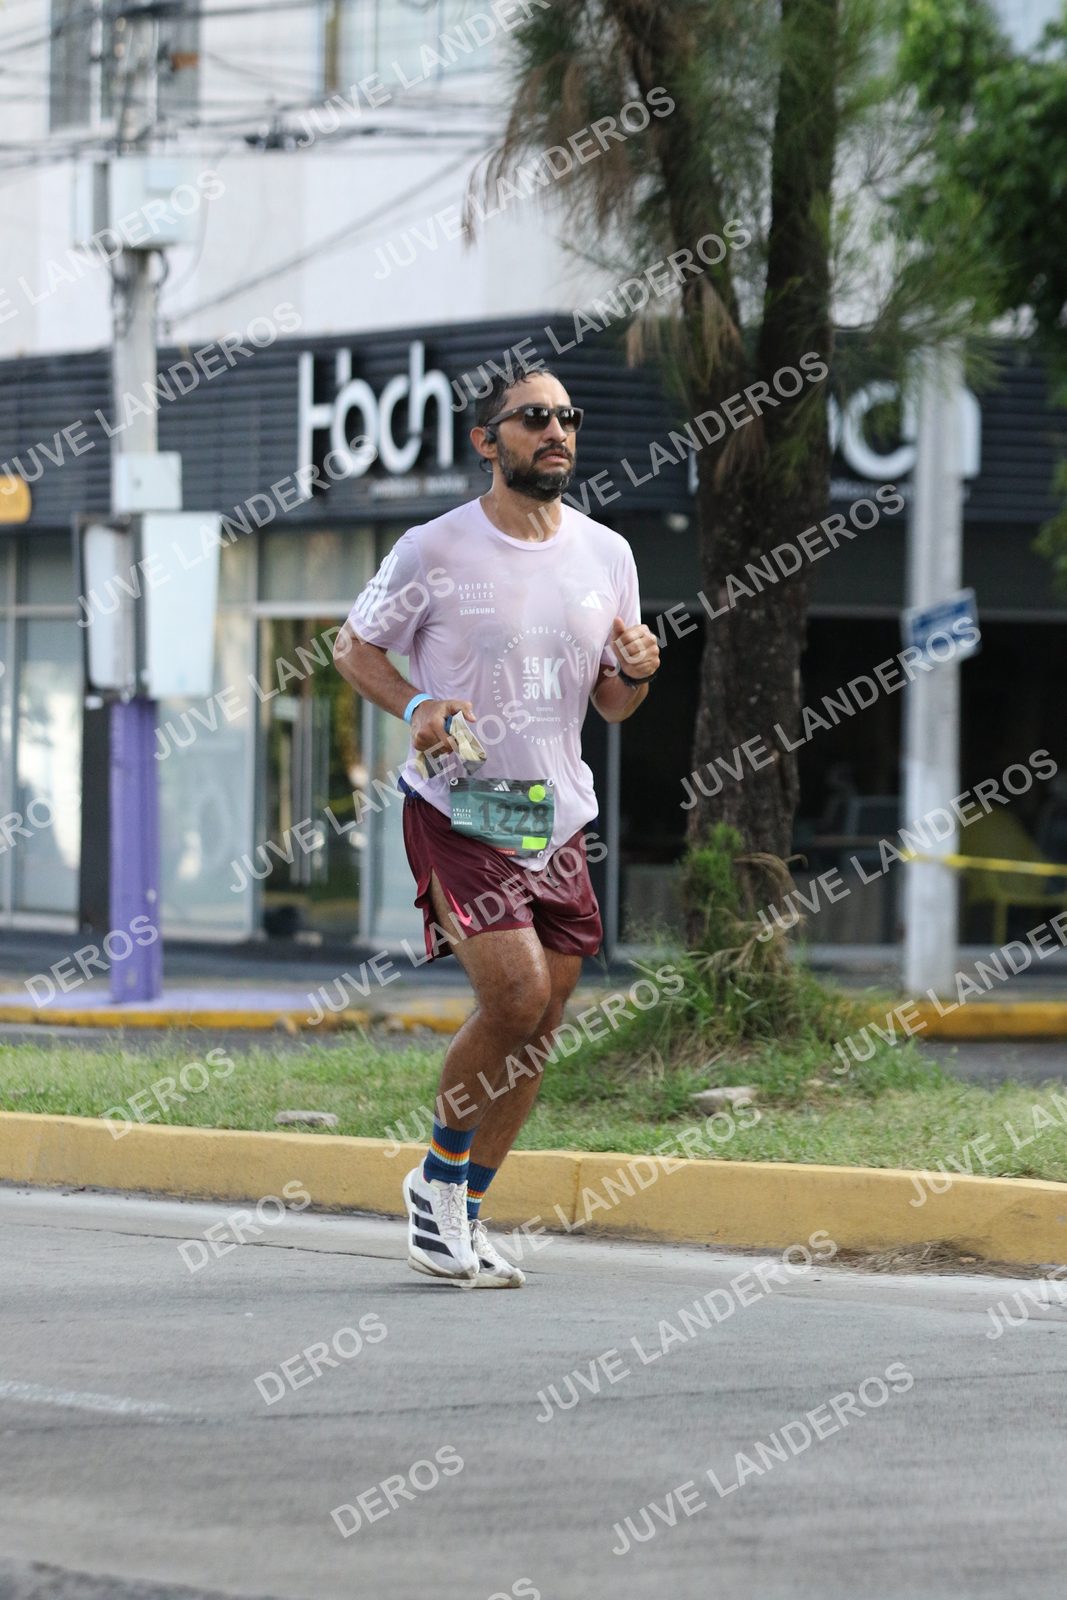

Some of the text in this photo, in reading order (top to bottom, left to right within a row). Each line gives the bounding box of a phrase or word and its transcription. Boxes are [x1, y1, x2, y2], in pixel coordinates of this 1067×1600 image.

[459, 592, 494, 600] SPLITS
[459, 607, 496, 616] SAMSUNG
[522, 656, 540, 674] 15
[543, 657, 566, 699] K
[522, 682, 540, 700] 30
[479, 801, 549, 835] 1228
